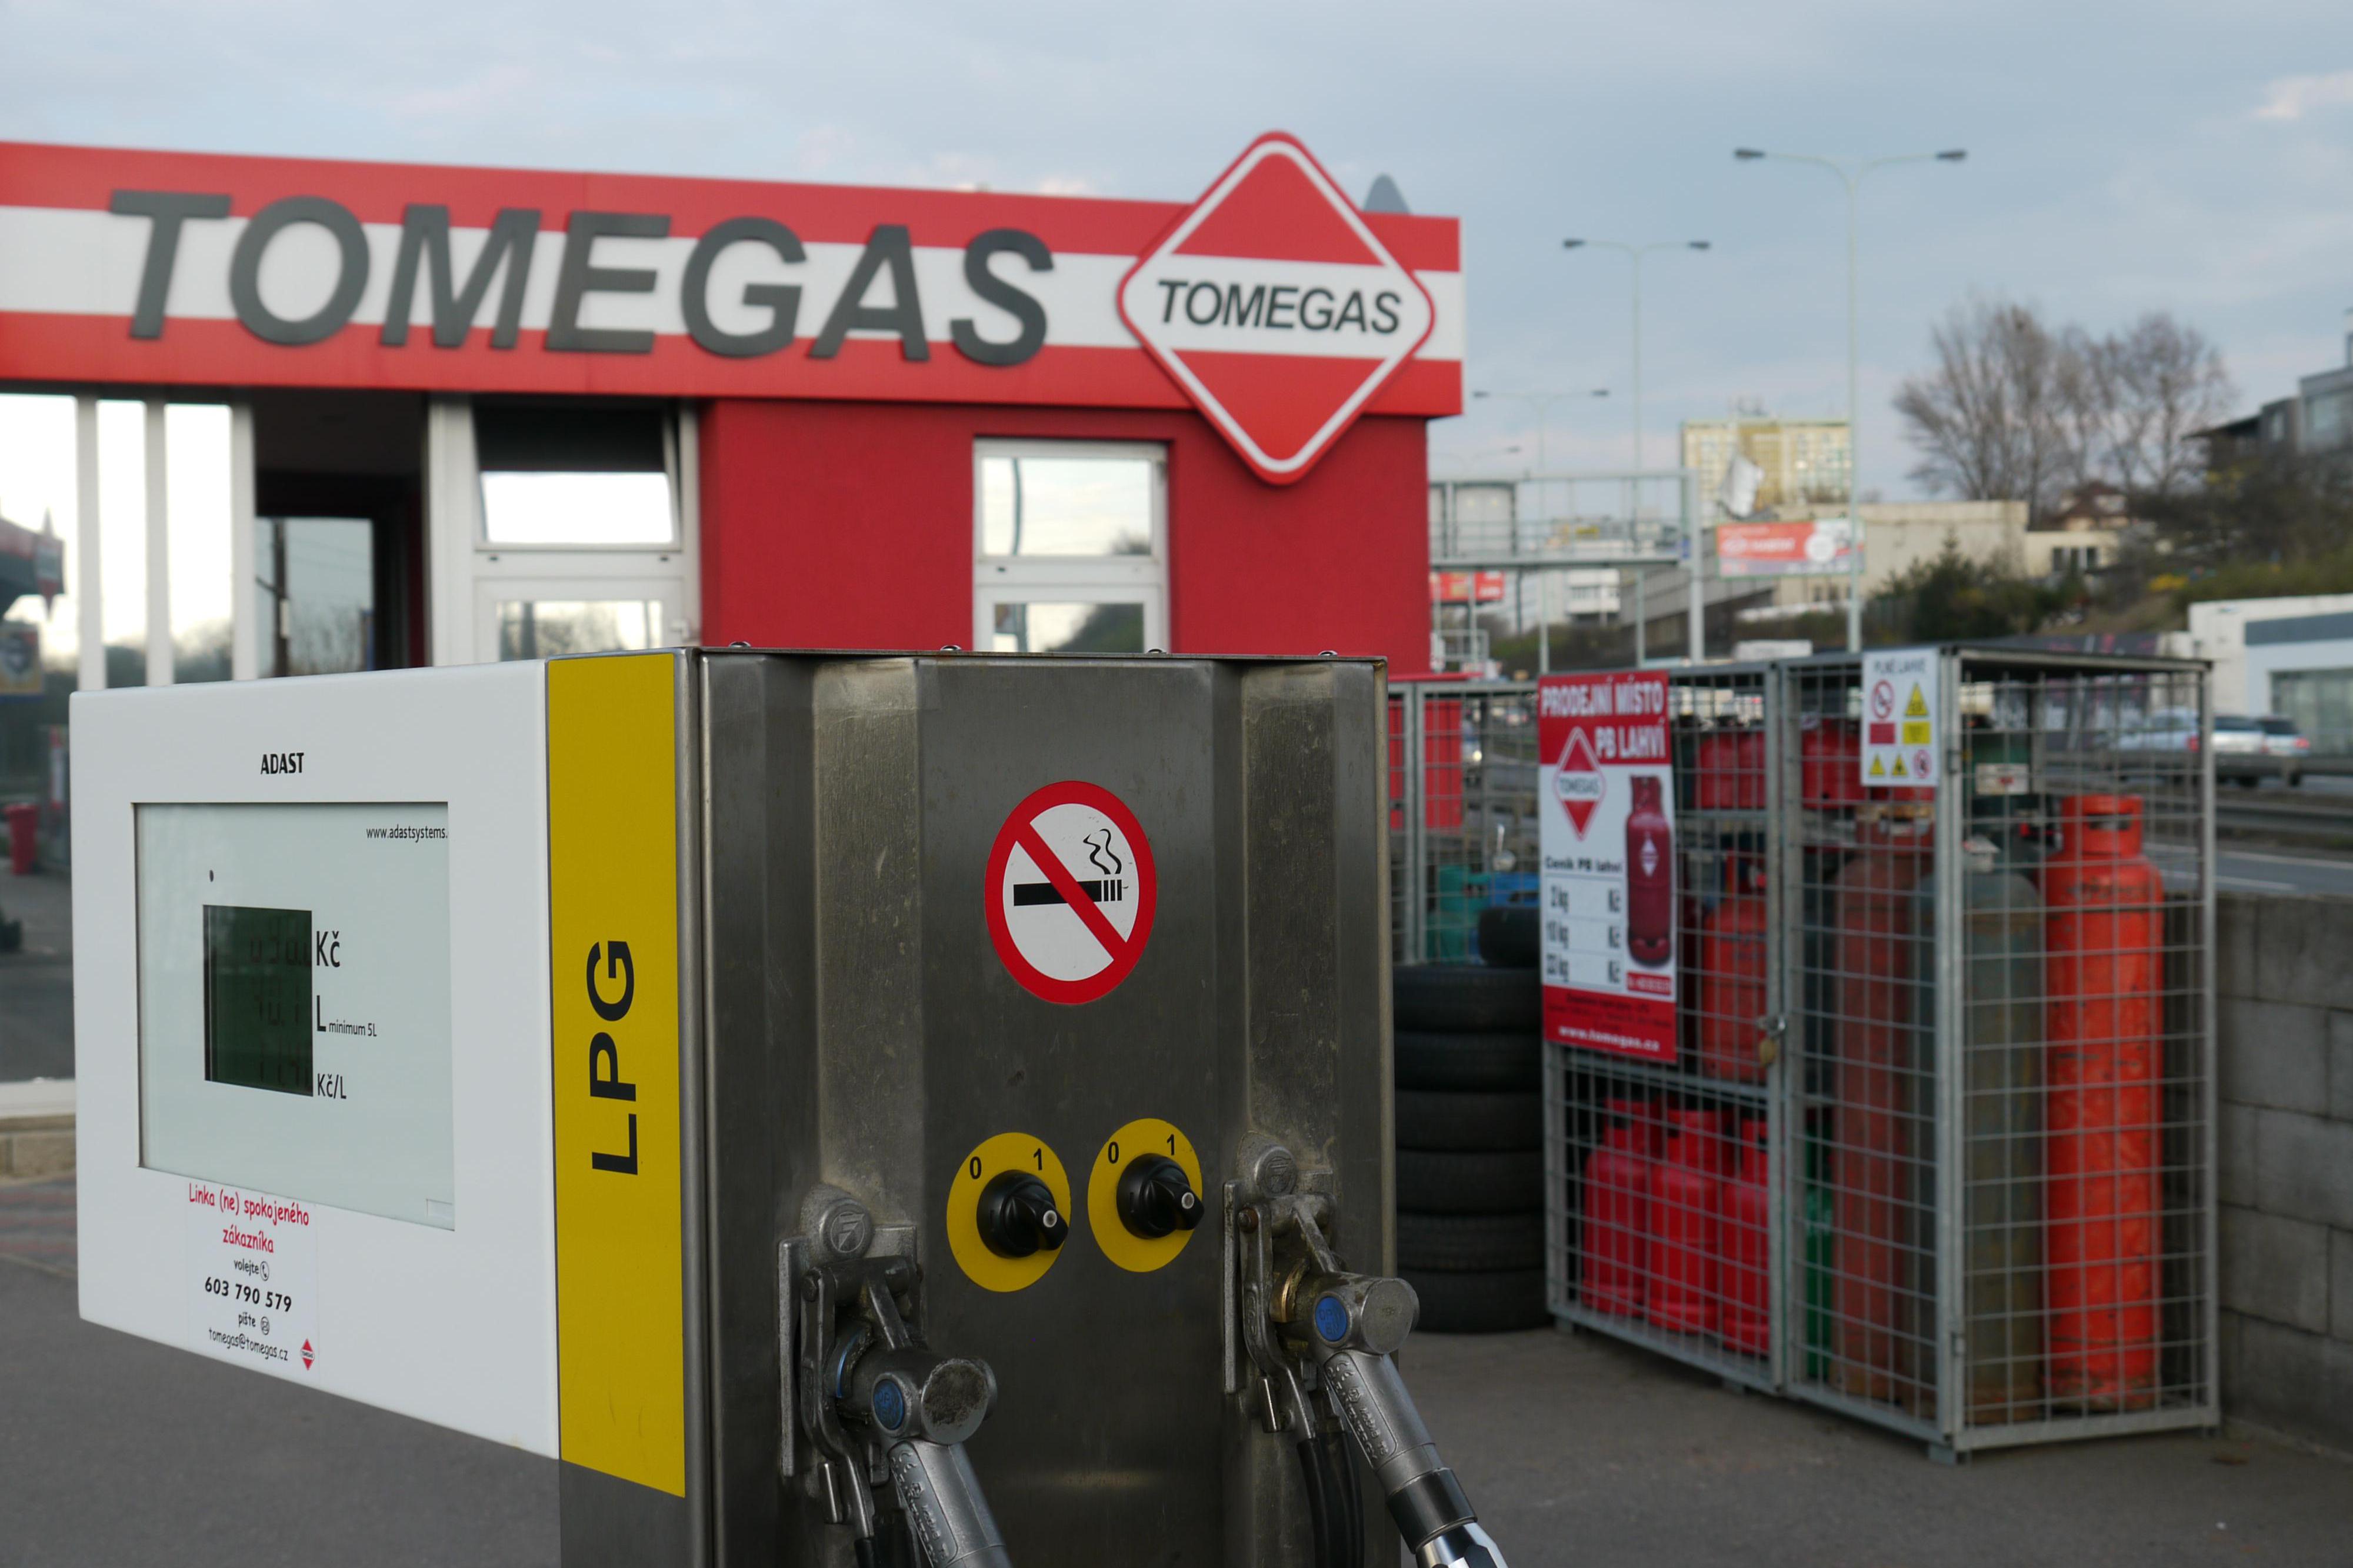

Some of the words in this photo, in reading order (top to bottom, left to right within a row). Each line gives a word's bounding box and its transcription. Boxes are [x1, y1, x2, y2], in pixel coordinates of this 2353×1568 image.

[109, 189, 1054, 367] TOMEGAS
[1158, 279, 1402, 334] TOMEGAS
[1541, 676, 1612, 717] PRODEJNÍ
[1615, 675, 1664, 715] MÍSTO
[1595, 726, 1616, 759] PB
[1618, 717, 1666, 759] LAHVÍ
[261, 752, 304, 775] ADAST
[316, 930, 341, 968] Kč
[316, 995, 326, 1032] L
[329, 1020, 366, 1036] minimum
[368, 1022, 377, 1037] 5L
[586, 940, 638, 1175] LPG
[318, 1074, 347, 1099] Kč/L
[969, 1156, 982, 1179] 0
[1033, 1147, 1043, 1170] 1
[1108, 1141, 1119, 1164] 0
[1166, 1134, 1175, 1156] 1
[189, 1183, 215, 1206] Linka
[219, 1189, 240, 1216] (ne)
[244, 1196, 309, 1226] spokojeného
[223, 1225, 274, 1253] zákazníka
[234, 1258, 259, 1276] volejte
[205, 1277, 229, 1297] 603
[235, 1283, 260, 1305] 790
[265, 1292, 292, 1312] 579
[209, 1327, 288, 1360] tomegas@tomegas.cz
